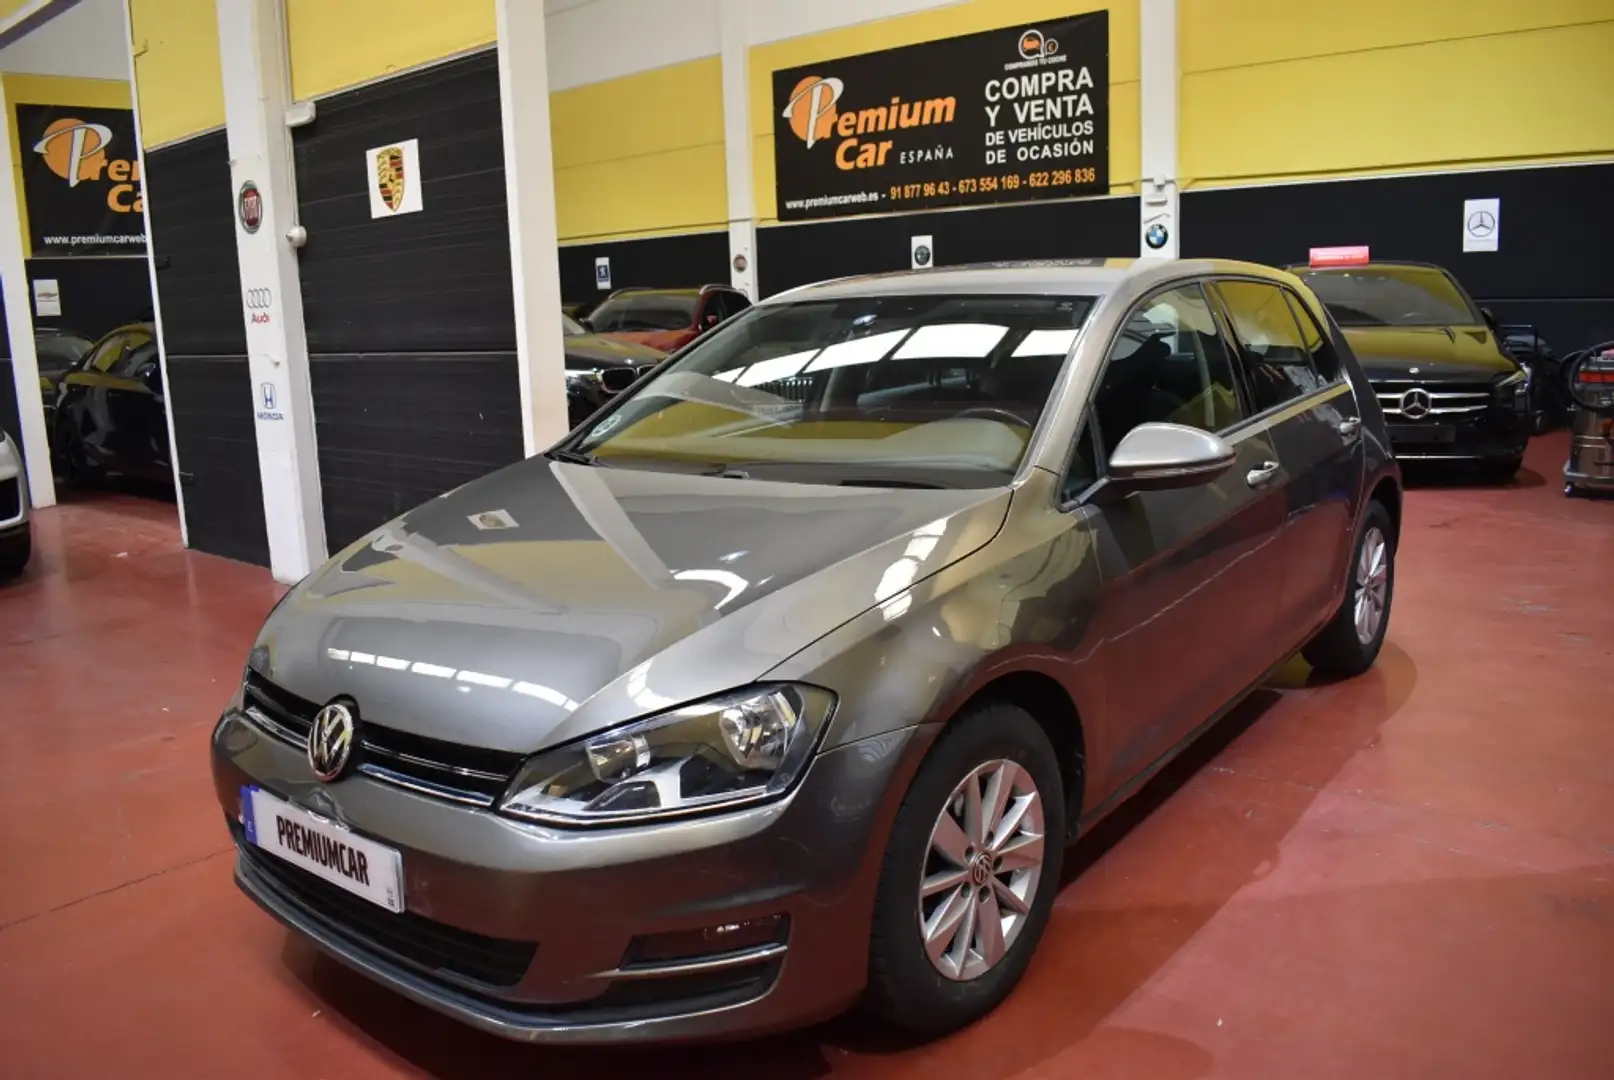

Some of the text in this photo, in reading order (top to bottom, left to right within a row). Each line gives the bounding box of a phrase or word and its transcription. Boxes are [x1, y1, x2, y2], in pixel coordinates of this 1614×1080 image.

[985, 66, 1094, 102] COMPRA
[782, 76, 956, 149] Premium
[984, 93, 1094, 127] Y VENTA
[985, 120, 1094, 146] DE VEHÍCULOS
[33, 123, 140, 187] Pre
[836, 138, 954, 171] Car ESPAÑA
[985, 137, 1094, 165] DE OCASIÓN
[890, 186, 902, 200] 91
[904, 184, 921, 199] 877
[923, 182, 936, 197] 96
[937, 181, 950, 195] 43
[958, 178, 977, 194] 673
[979, 176, 998, 191] 554
[1001, 174, 1020, 189] 169
[1029, 172, 1049, 187] 622
[1051, 169, 1072, 186] 296
[1074, 168, 1096, 183] 836
[276, 815, 370, 886] PREMIUMCAR
